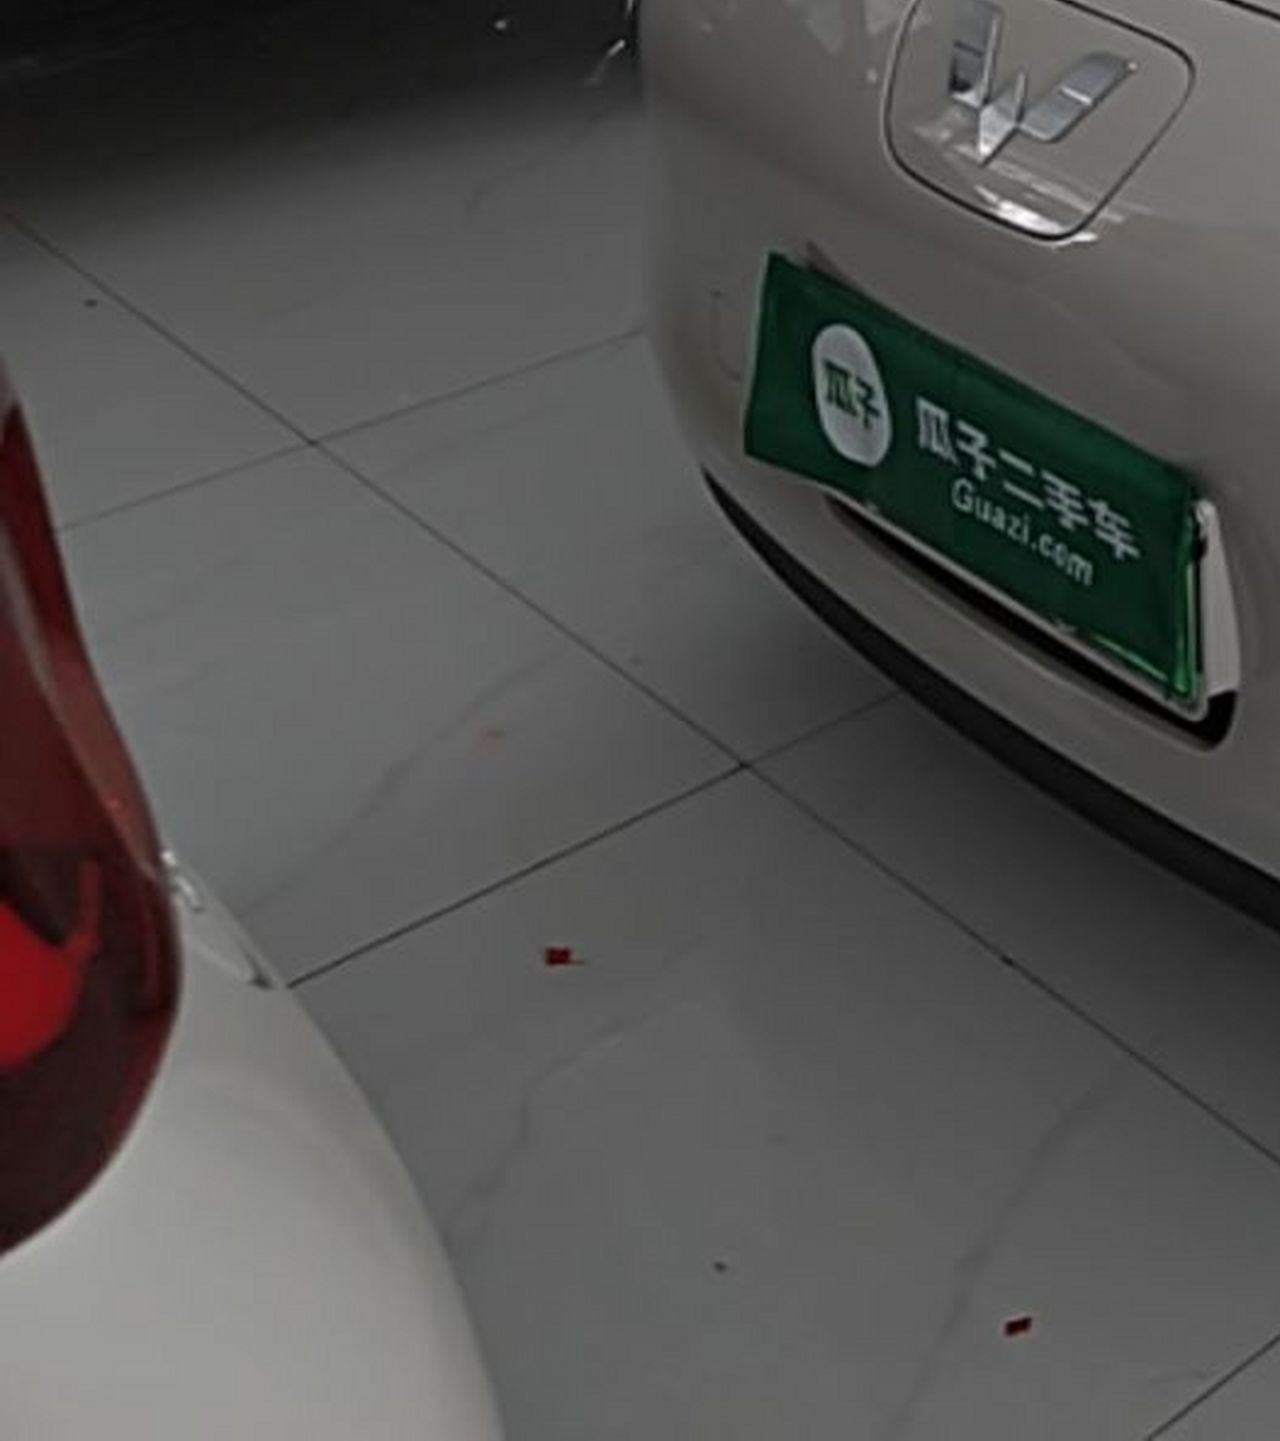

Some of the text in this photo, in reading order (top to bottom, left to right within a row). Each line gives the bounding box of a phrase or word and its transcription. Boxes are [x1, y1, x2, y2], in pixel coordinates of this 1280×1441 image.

[825, 360, 881, 429] 瓜子
[915, 396, 1140, 559] 瓜子二手车
[952, 477, 1094, 586] Guazi.com
